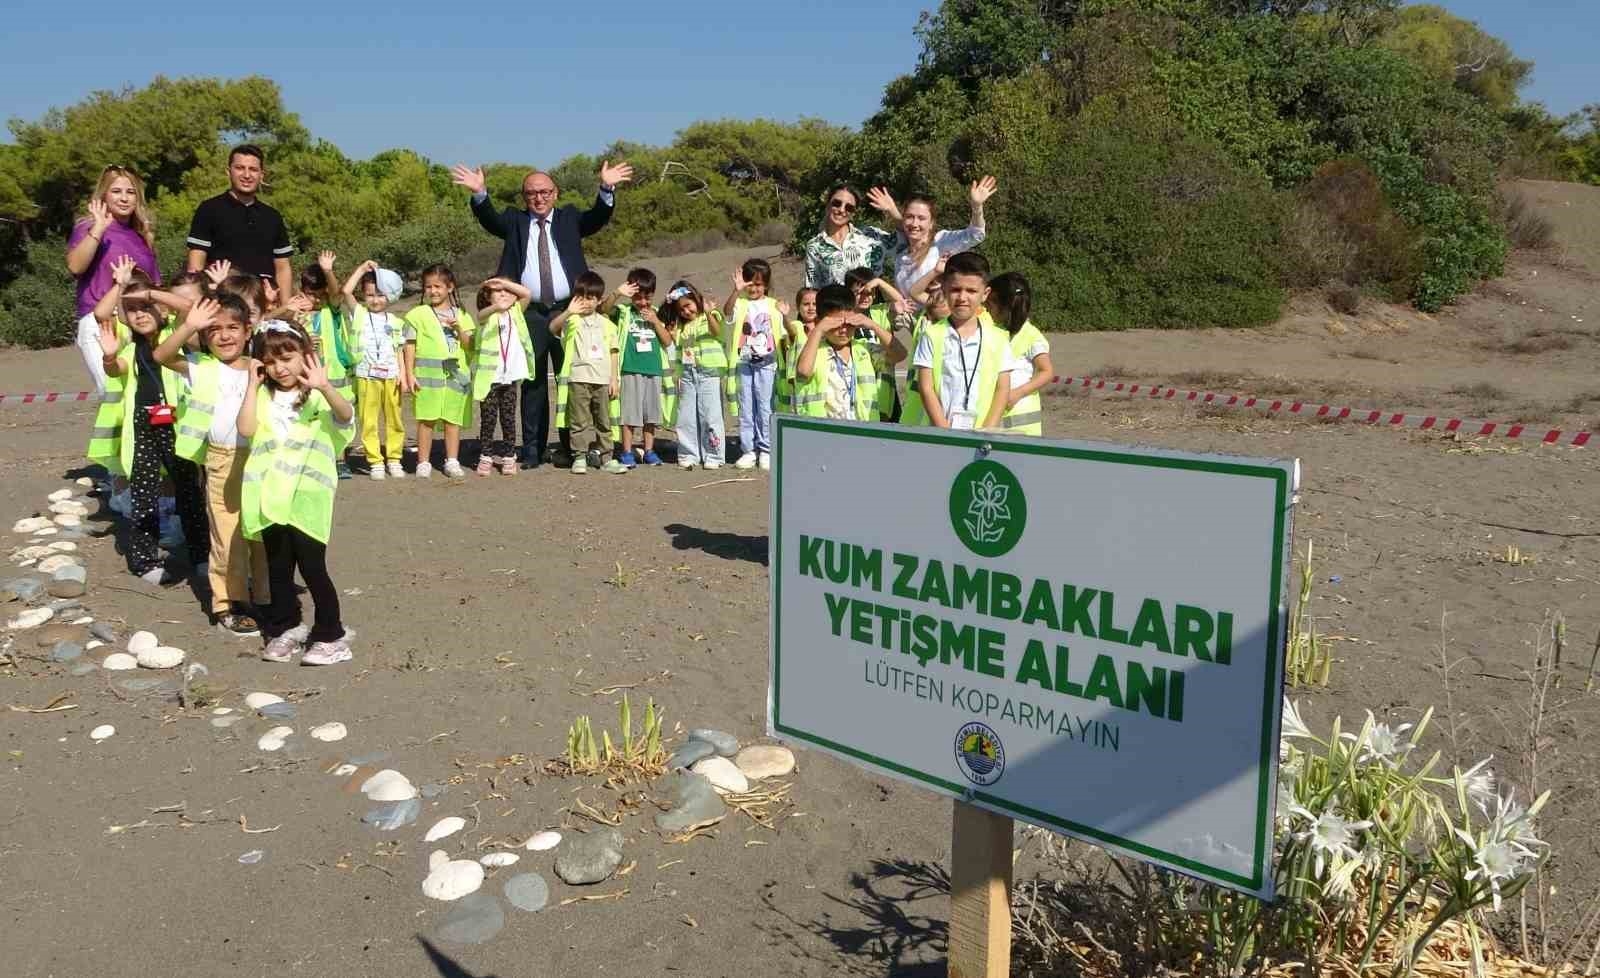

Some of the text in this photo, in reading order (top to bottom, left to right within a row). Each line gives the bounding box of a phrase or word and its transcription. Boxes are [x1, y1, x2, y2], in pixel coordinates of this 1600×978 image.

[799, 535, 1234, 666] KUM ZAMBAKLARI
[824, 592, 1185, 723] YETİŞME ALANI
[864, 659, 1120, 752] LÜTFEN KOPARMAYIN
